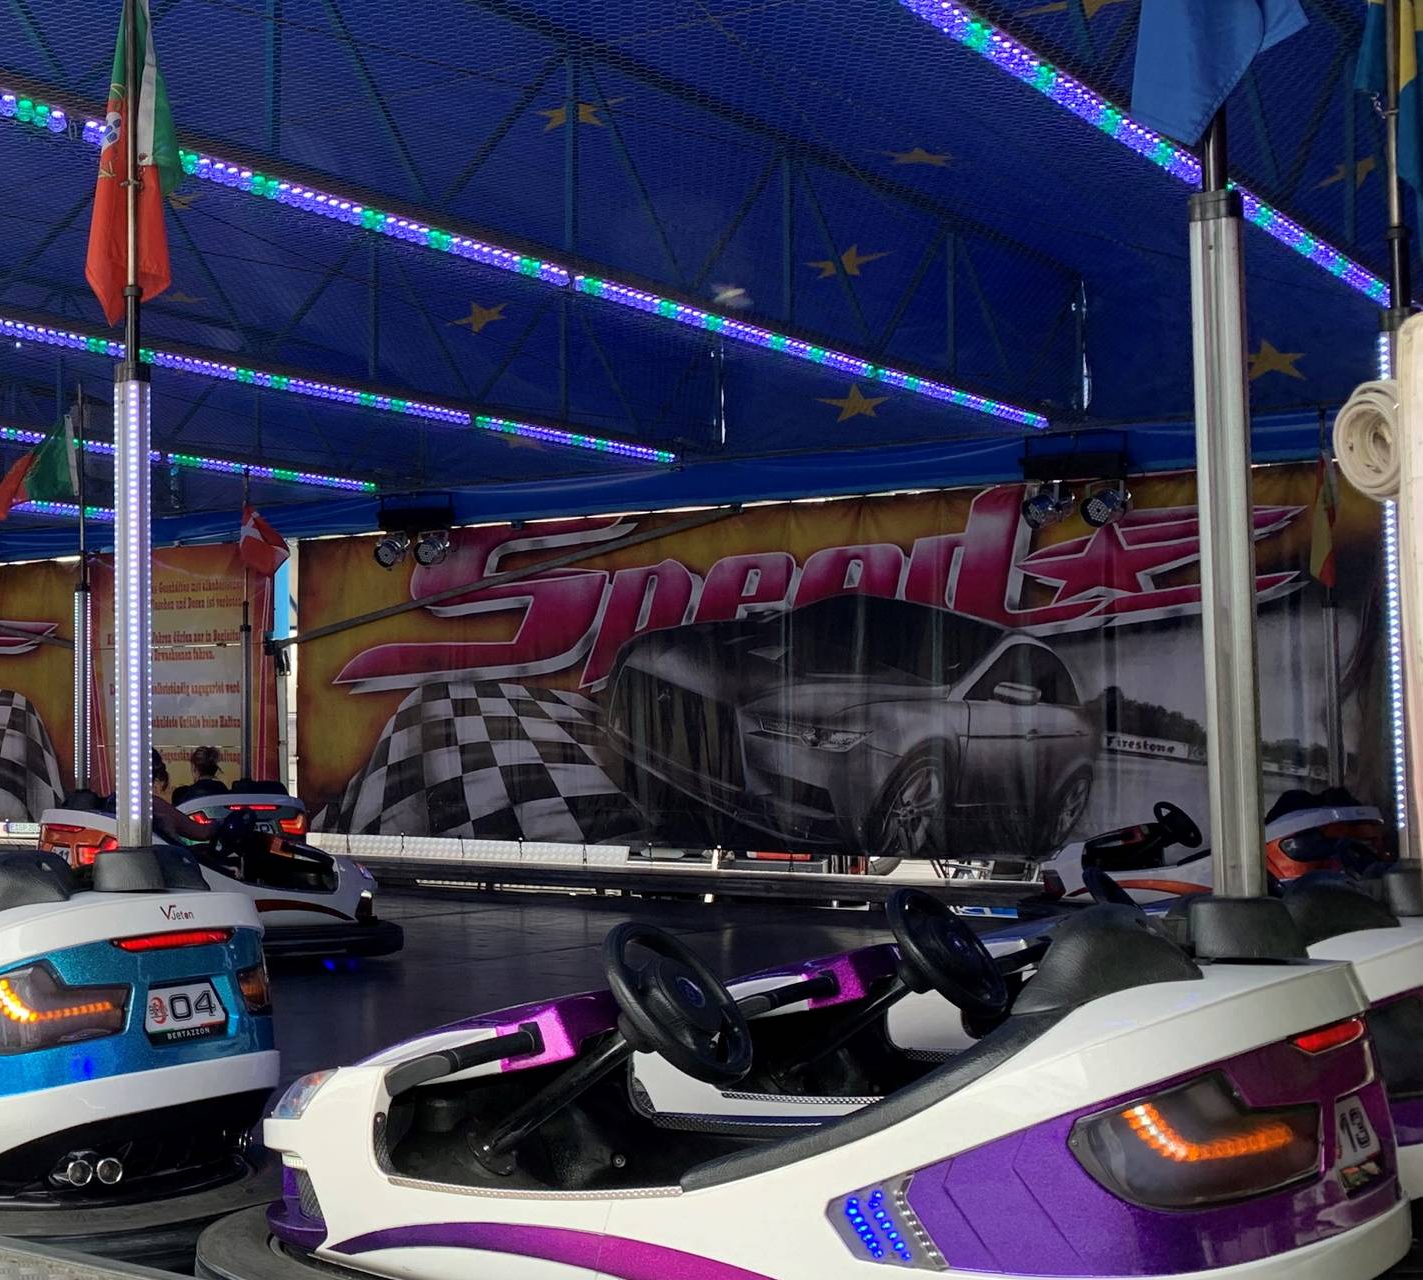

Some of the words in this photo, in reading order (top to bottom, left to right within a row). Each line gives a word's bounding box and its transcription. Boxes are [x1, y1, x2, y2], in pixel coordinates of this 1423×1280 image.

[333, 485, 1035, 692] Speed
[1105, 735, 1176, 754] Firestone
[168, 990, 216, 1022] 04
[167, 1027, 210, 1041] BERTAZZON
[1339, 1106, 1371, 1153] 13
